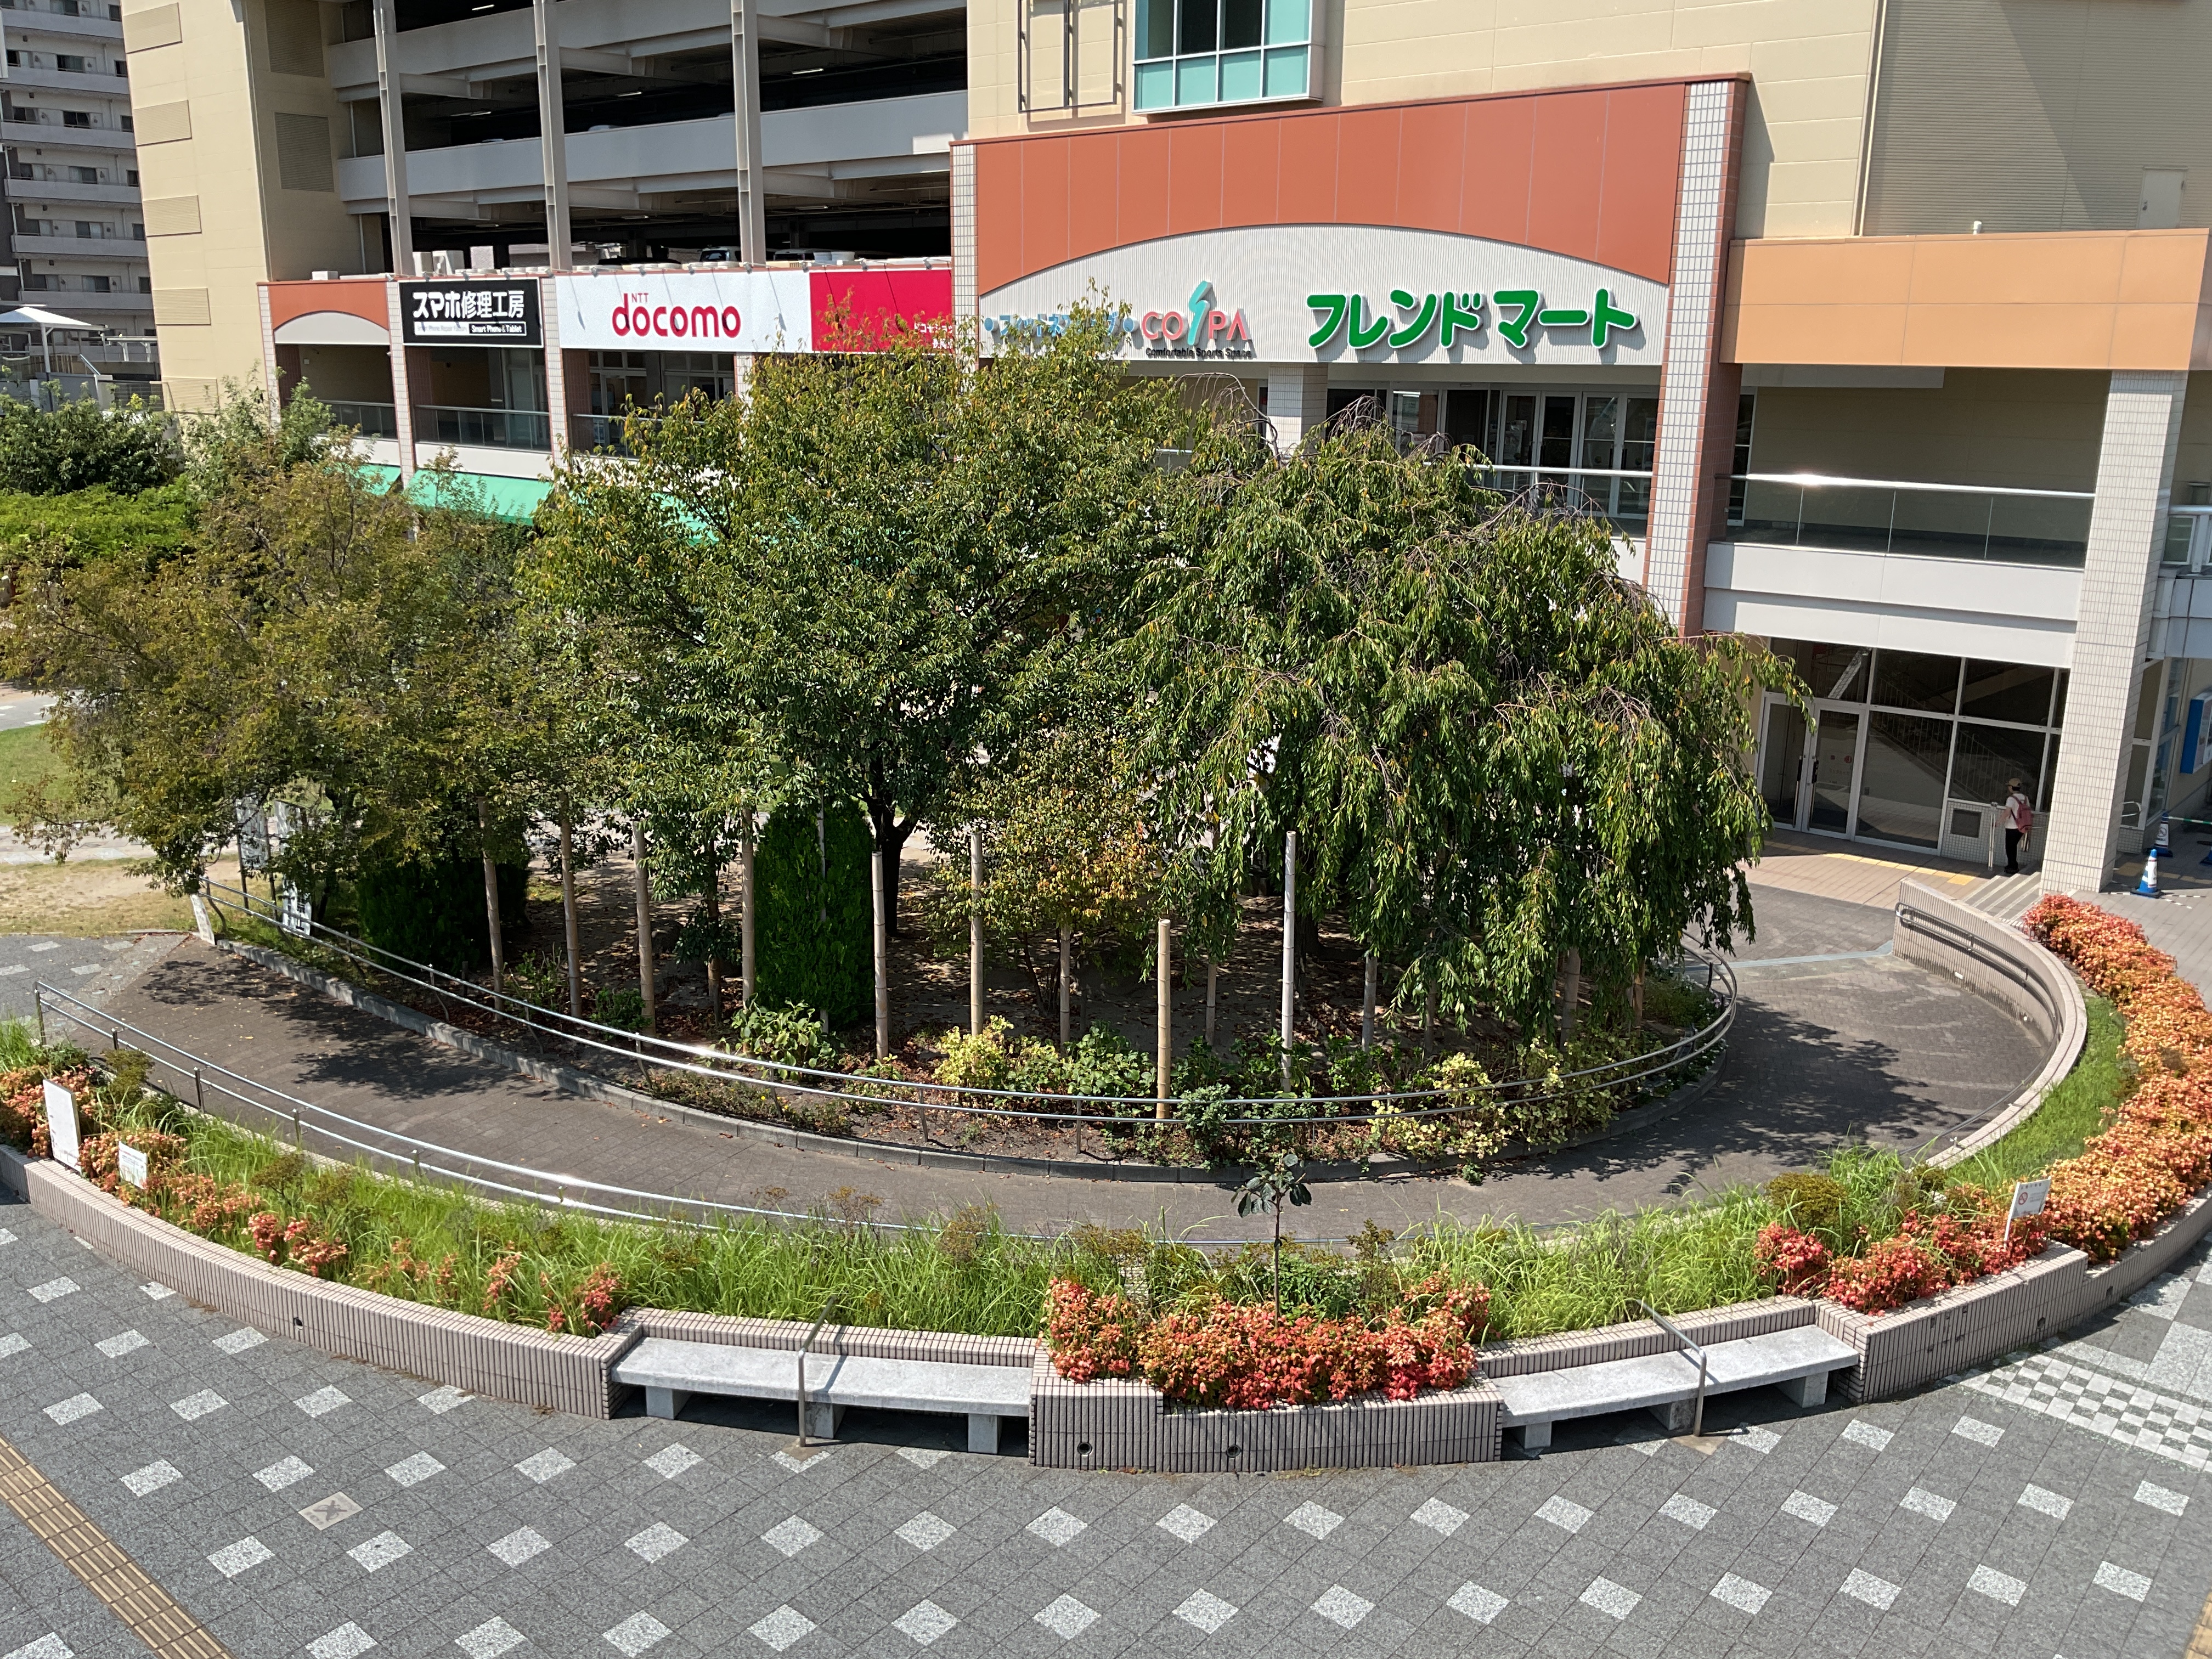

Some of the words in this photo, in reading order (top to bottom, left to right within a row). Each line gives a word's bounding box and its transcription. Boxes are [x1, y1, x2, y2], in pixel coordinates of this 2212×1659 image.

[413, 290, 524, 318] スマホ修理工房
[631, 293, 648, 303] NTT
[612, 293, 741, 338] docomo
[1307, 288, 1639, 349] フレンドマート
[1146, 347, 1194, 356] Comfortable
[1196, 347, 1222, 358] Sports
[1226, 347, 1251, 358] Space
